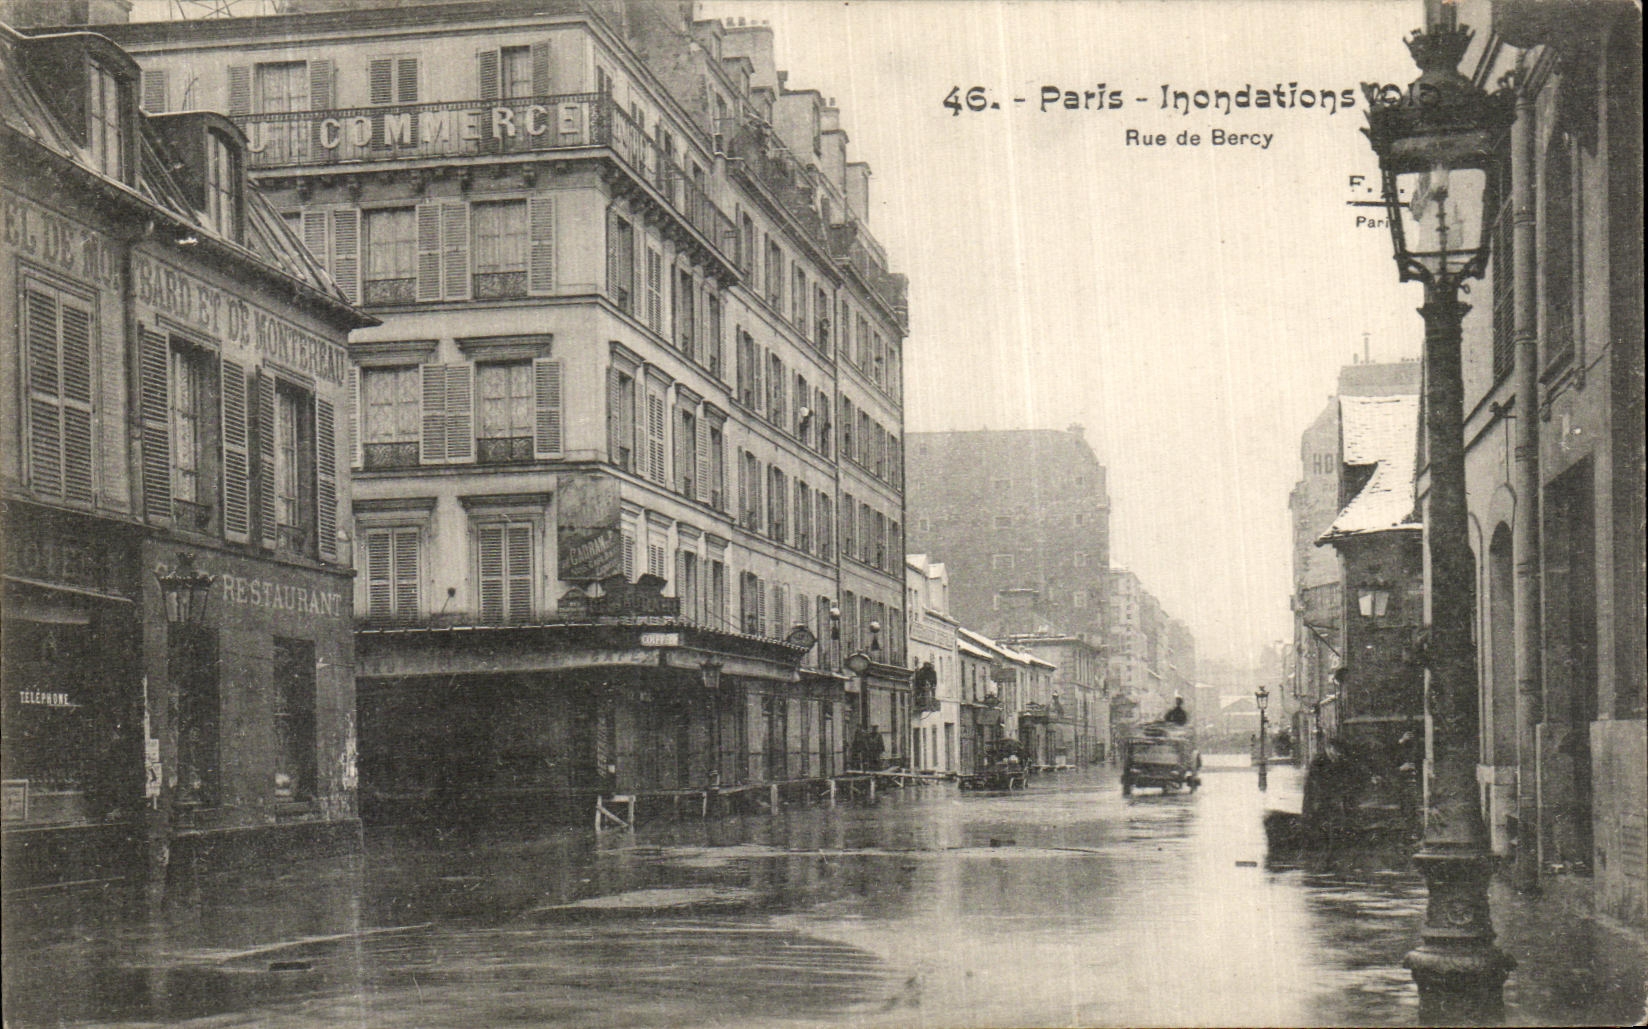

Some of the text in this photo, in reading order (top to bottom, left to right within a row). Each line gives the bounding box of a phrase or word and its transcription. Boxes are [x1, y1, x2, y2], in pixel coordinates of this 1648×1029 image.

[320, 101, 581, 149] COMMERCE
[227, 296, 250, 349] DE
[222, 573, 342, 617] RESTAURANT
[19, 687, 70, 706] TÉLÉPHONE
